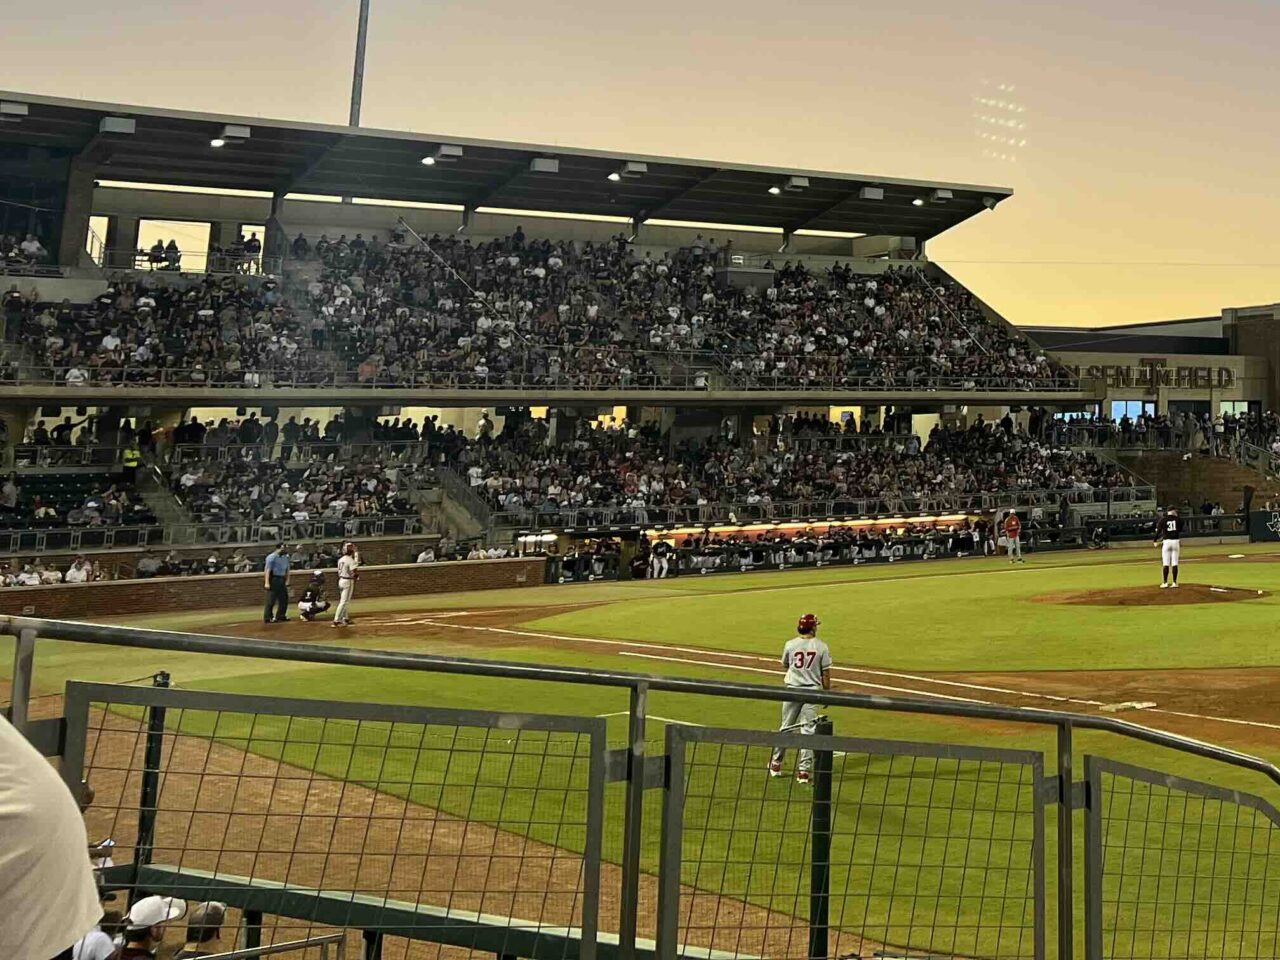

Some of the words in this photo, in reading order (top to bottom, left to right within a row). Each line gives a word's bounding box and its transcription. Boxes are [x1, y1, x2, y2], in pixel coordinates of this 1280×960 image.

[1176, 366, 1234, 389] FIELD
[1166, 520, 1177, 531] 31
[794, 651, 817, 669] 37
